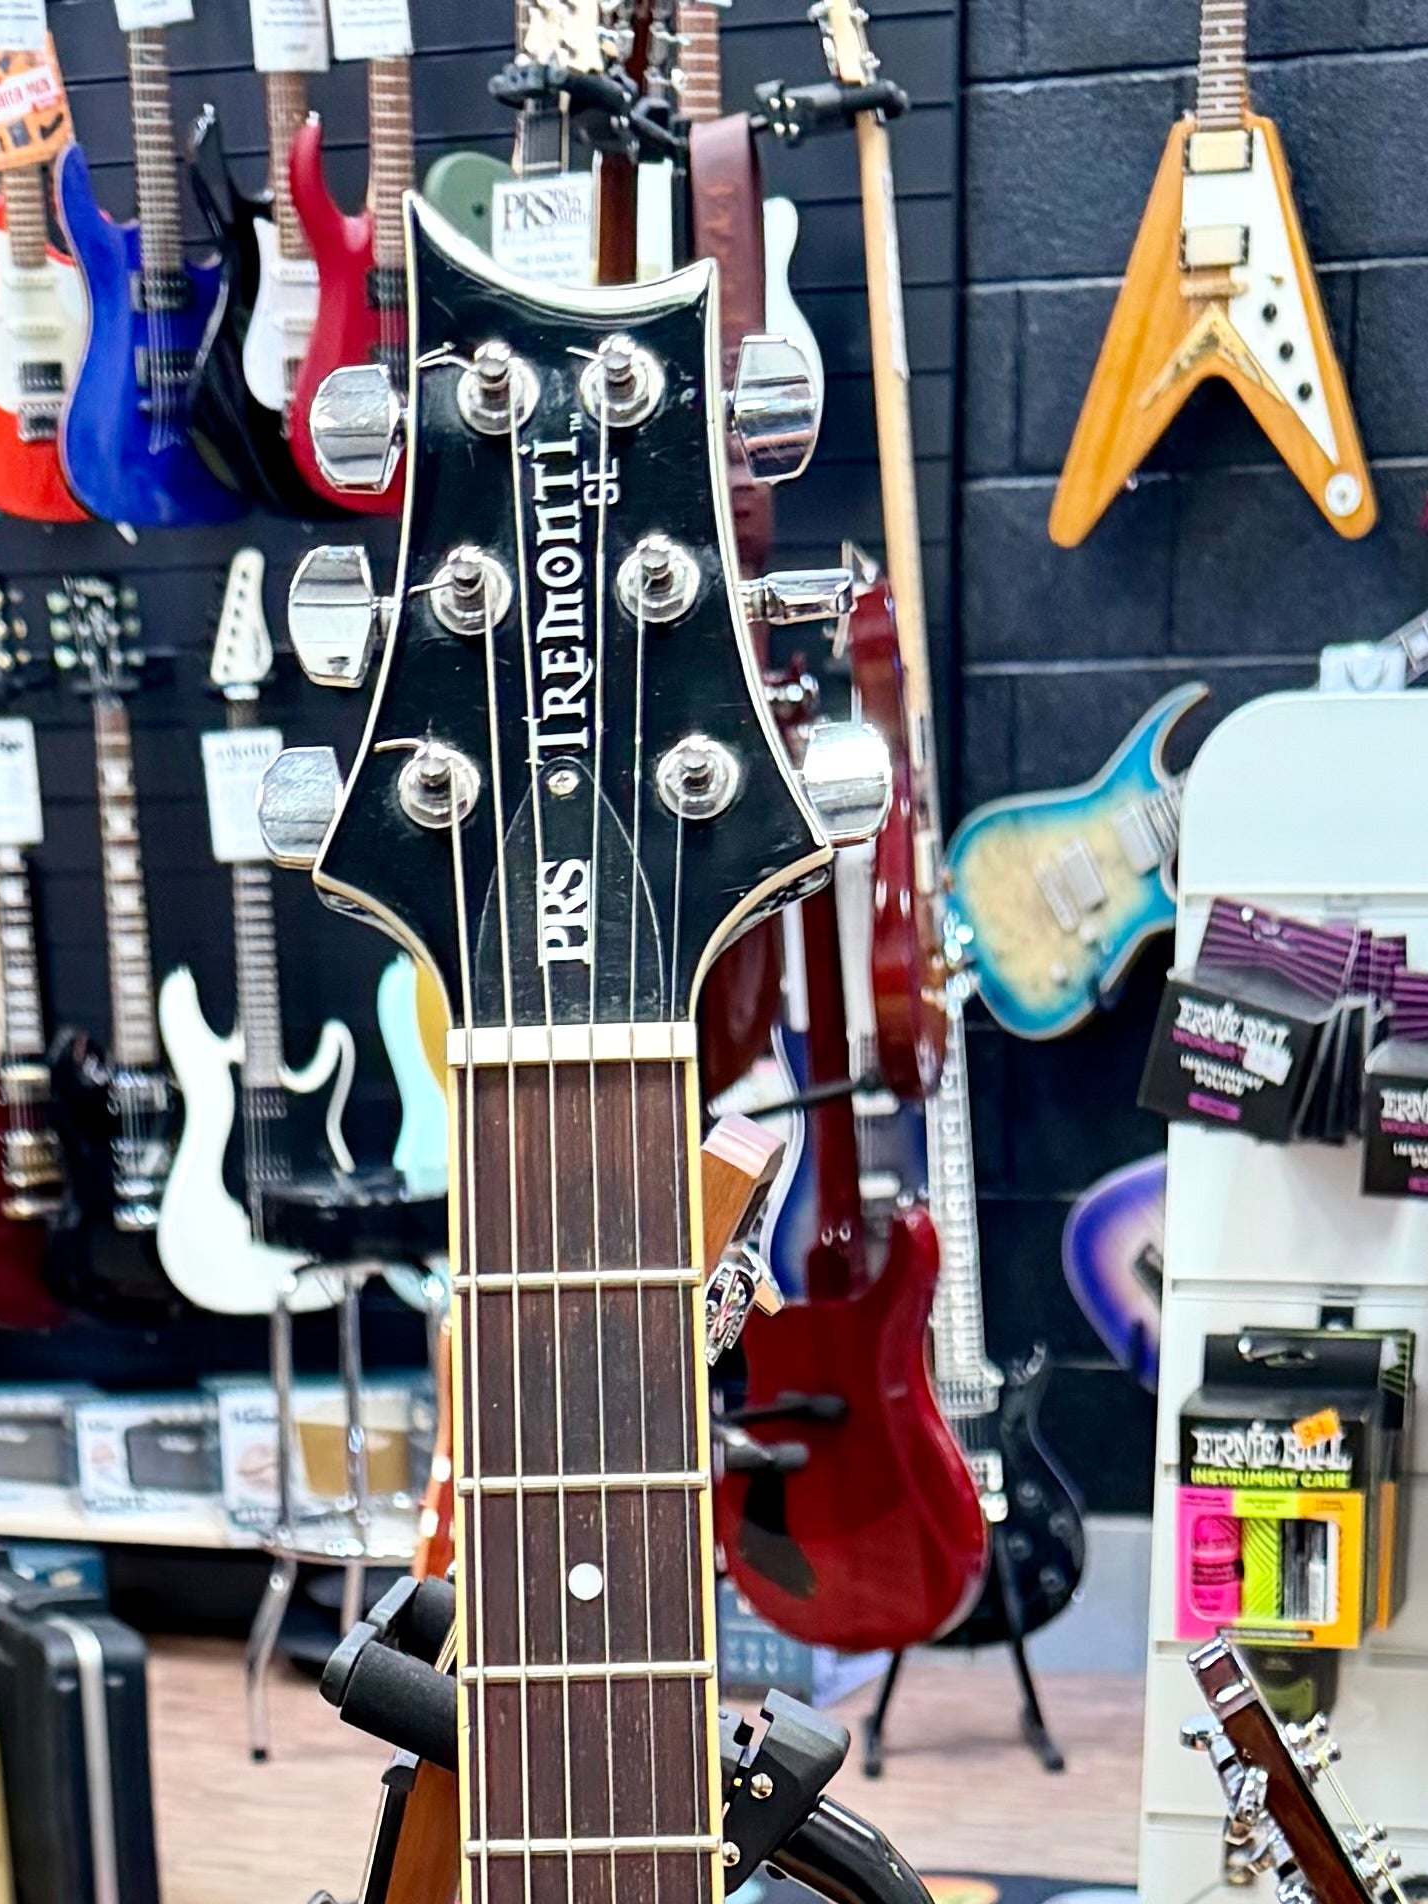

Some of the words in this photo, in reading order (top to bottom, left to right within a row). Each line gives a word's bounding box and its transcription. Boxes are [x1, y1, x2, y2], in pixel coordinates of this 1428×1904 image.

[582, 456, 622, 508] SE
[538, 857, 592, 967] PRS
[1190, 1419, 1279, 1470] ERNIE
[1190, 1466, 1299, 1488] INSTRUMENT
[1300, 1470, 1352, 1489] CARE
